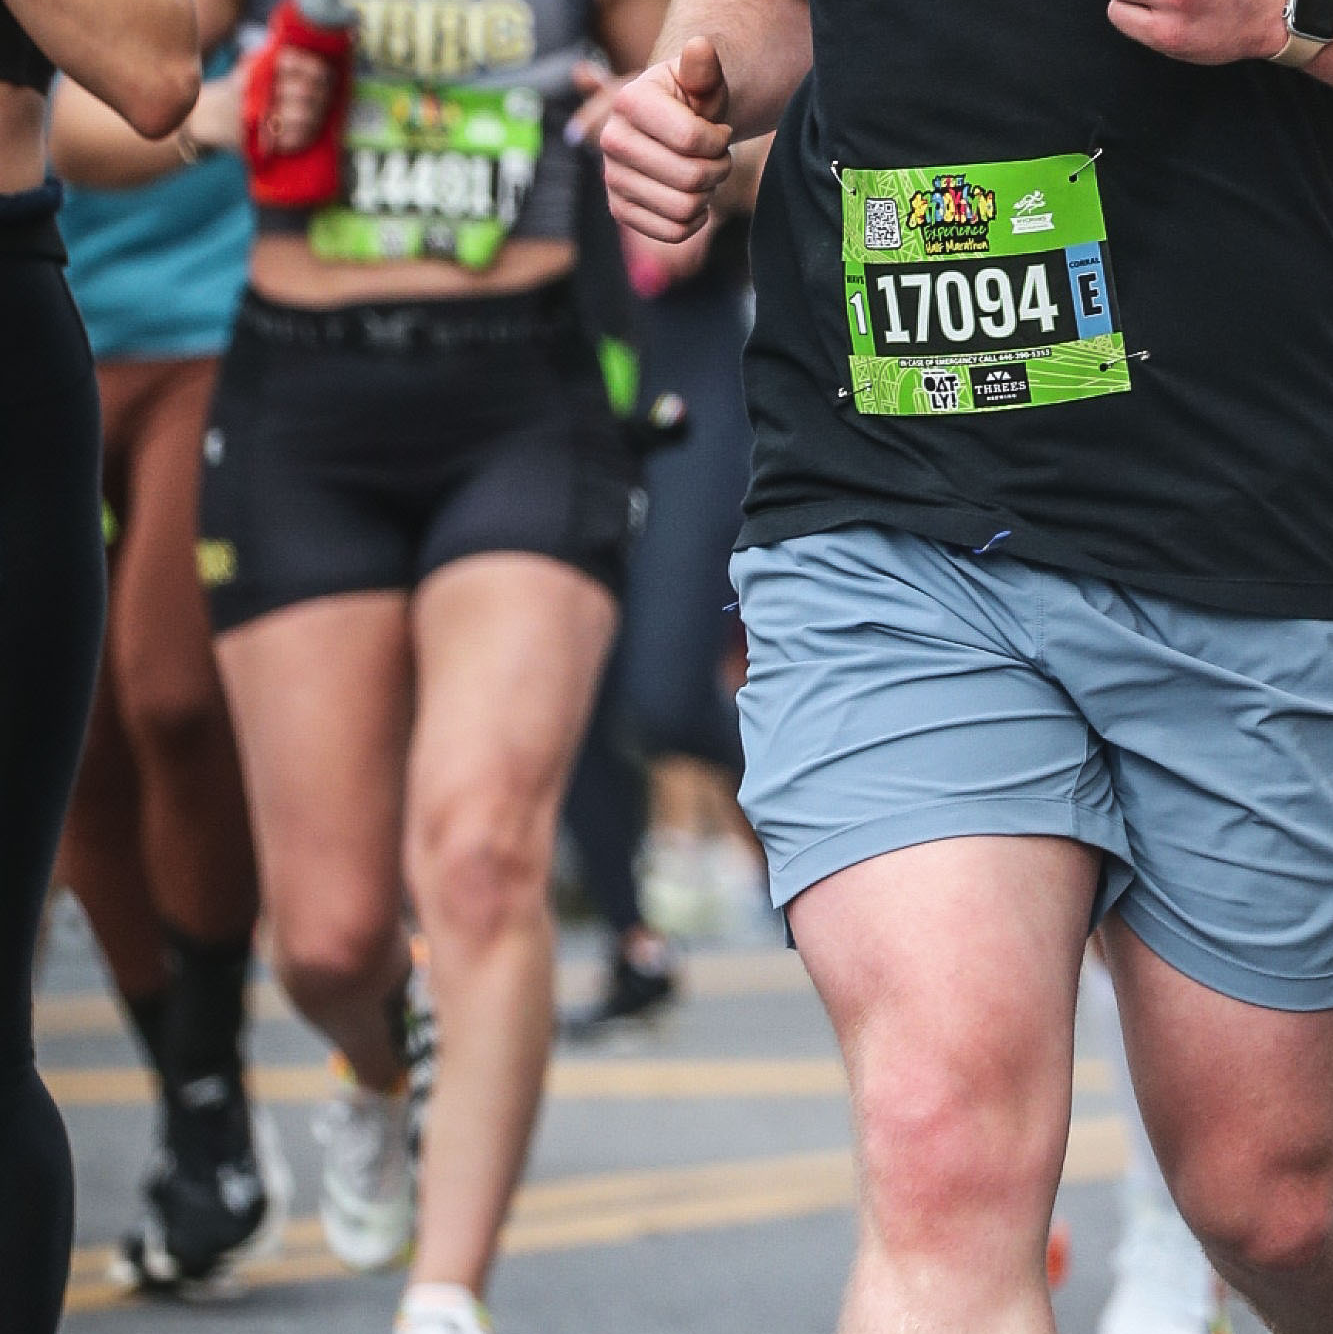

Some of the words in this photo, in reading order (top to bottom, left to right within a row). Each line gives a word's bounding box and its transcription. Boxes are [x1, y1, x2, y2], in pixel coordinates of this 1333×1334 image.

[849, 291, 867, 335] 1
[877, 264, 1059, 344] 17094
[1077, 272, 1103, 318] E
[931, 392, 957, 409] LY!
[974, 380, 1027, 395] THREES
